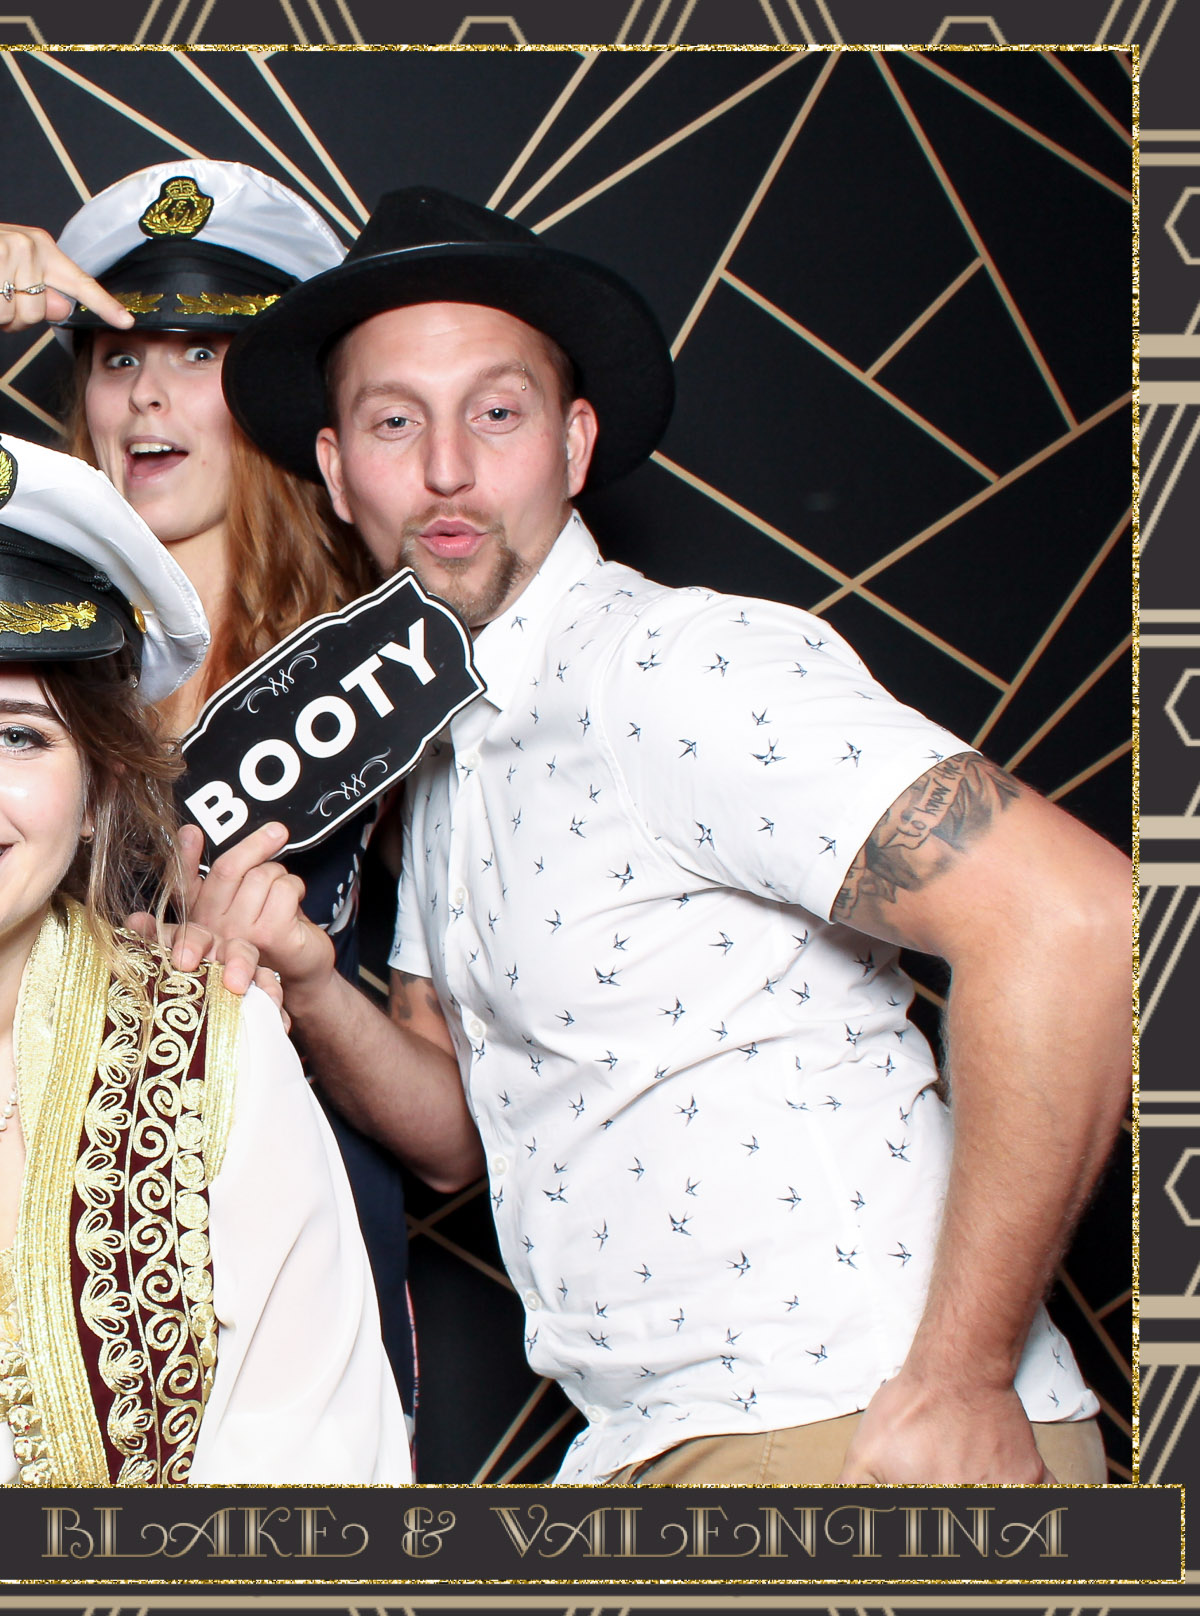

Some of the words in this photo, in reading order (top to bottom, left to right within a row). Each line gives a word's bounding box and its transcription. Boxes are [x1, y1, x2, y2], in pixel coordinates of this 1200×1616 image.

[184, 617, 437, 846] BOOTY
[896, 820, 927, 837] to
[912, 778, 951, 816] know
